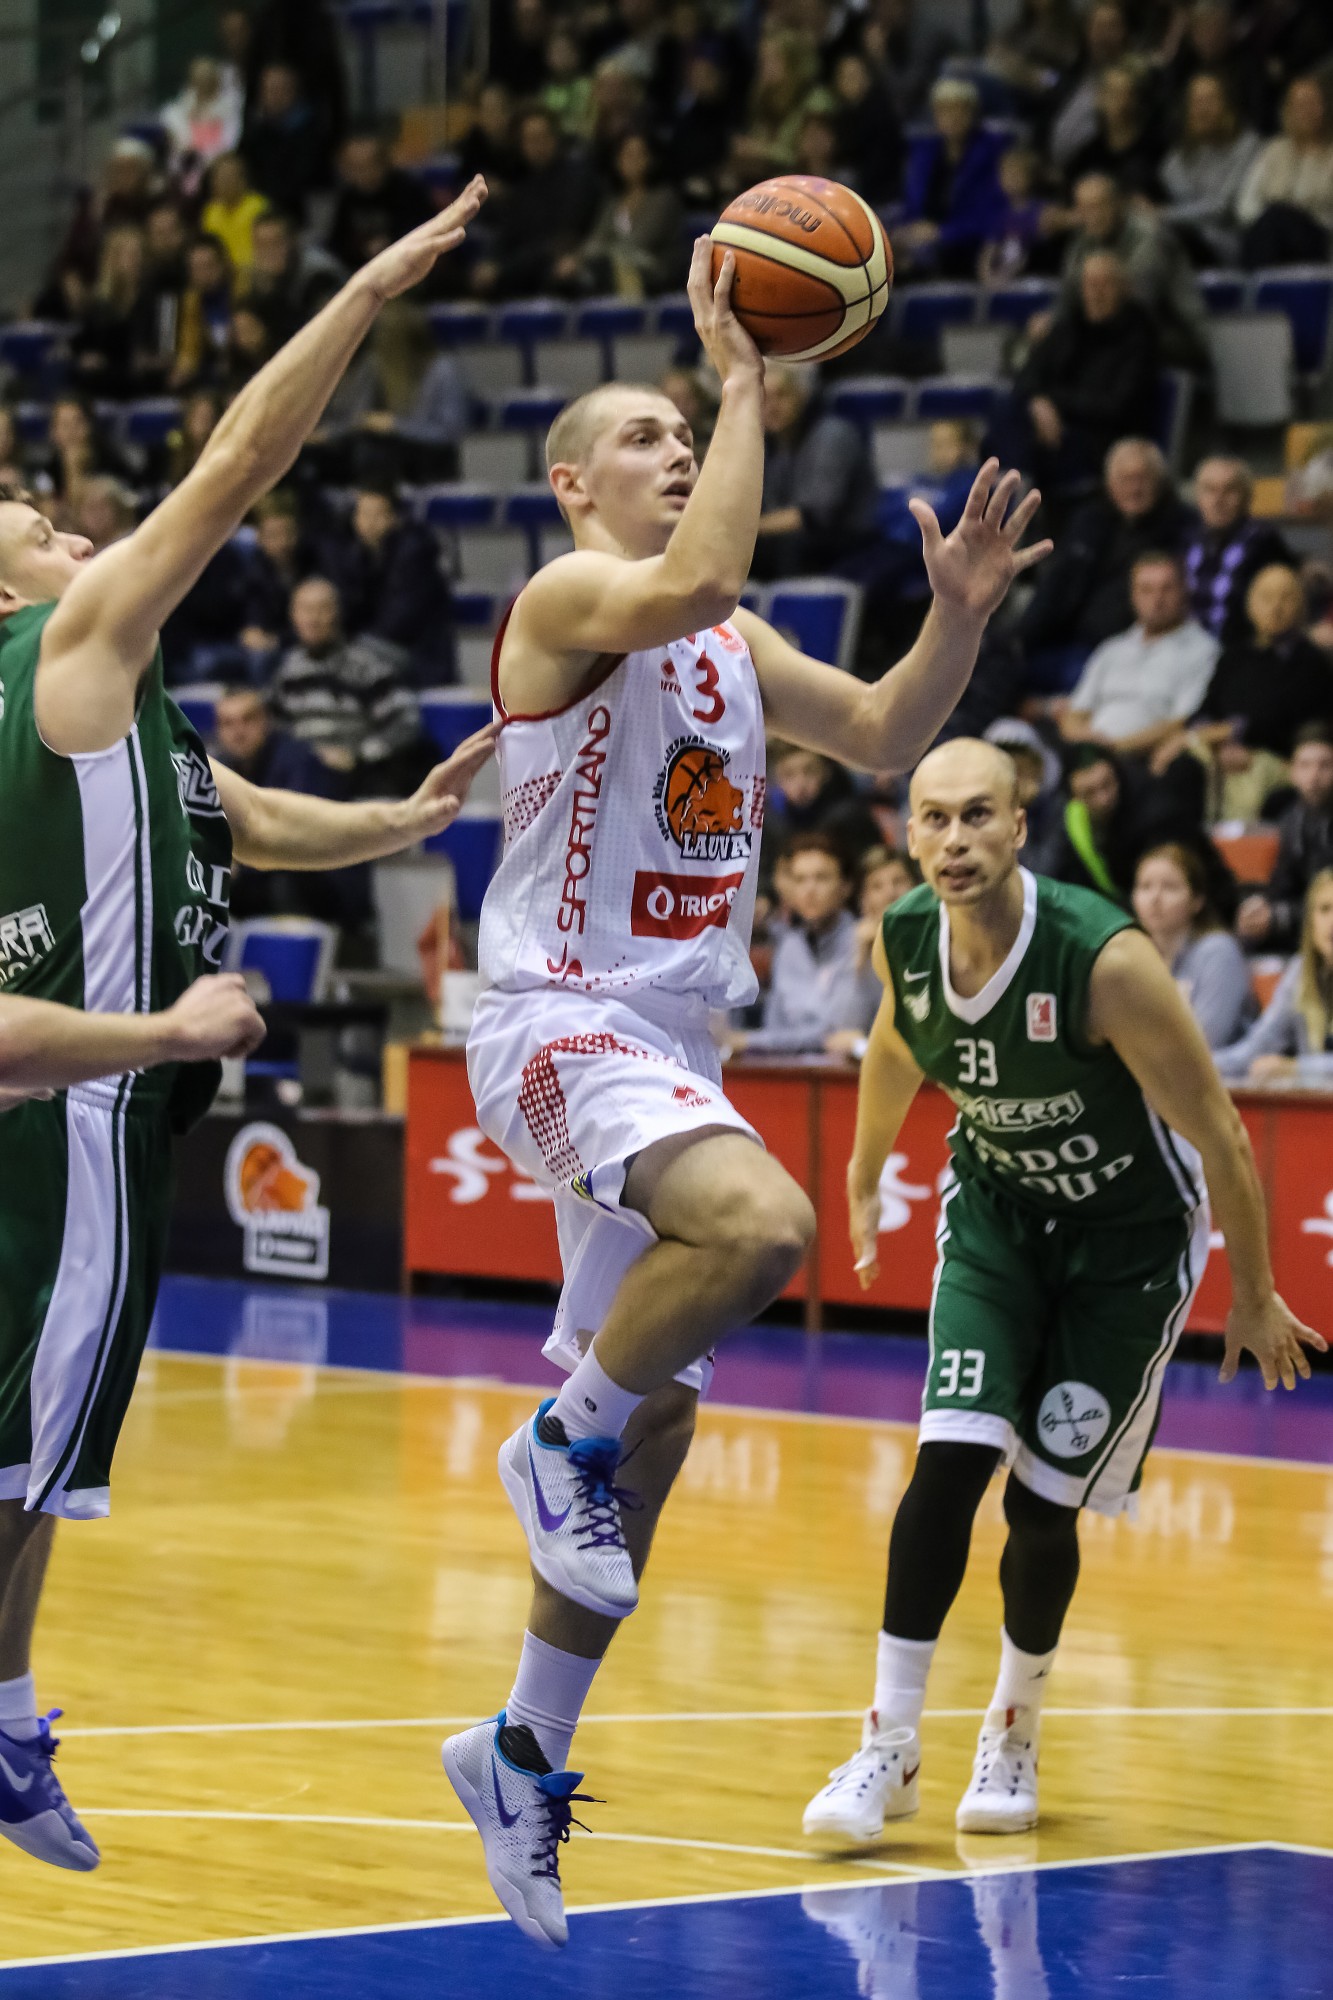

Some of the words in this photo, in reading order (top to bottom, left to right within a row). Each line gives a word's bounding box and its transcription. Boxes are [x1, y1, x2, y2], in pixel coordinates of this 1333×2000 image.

[693, 650, 726, 724] 3
[556, 705, 611, 935] SPORTLAND
[680, 832, 752, 861] LAUVA
[954, 1038, 999, 1087] 33
[936, 1348, 986, 1398] 33
